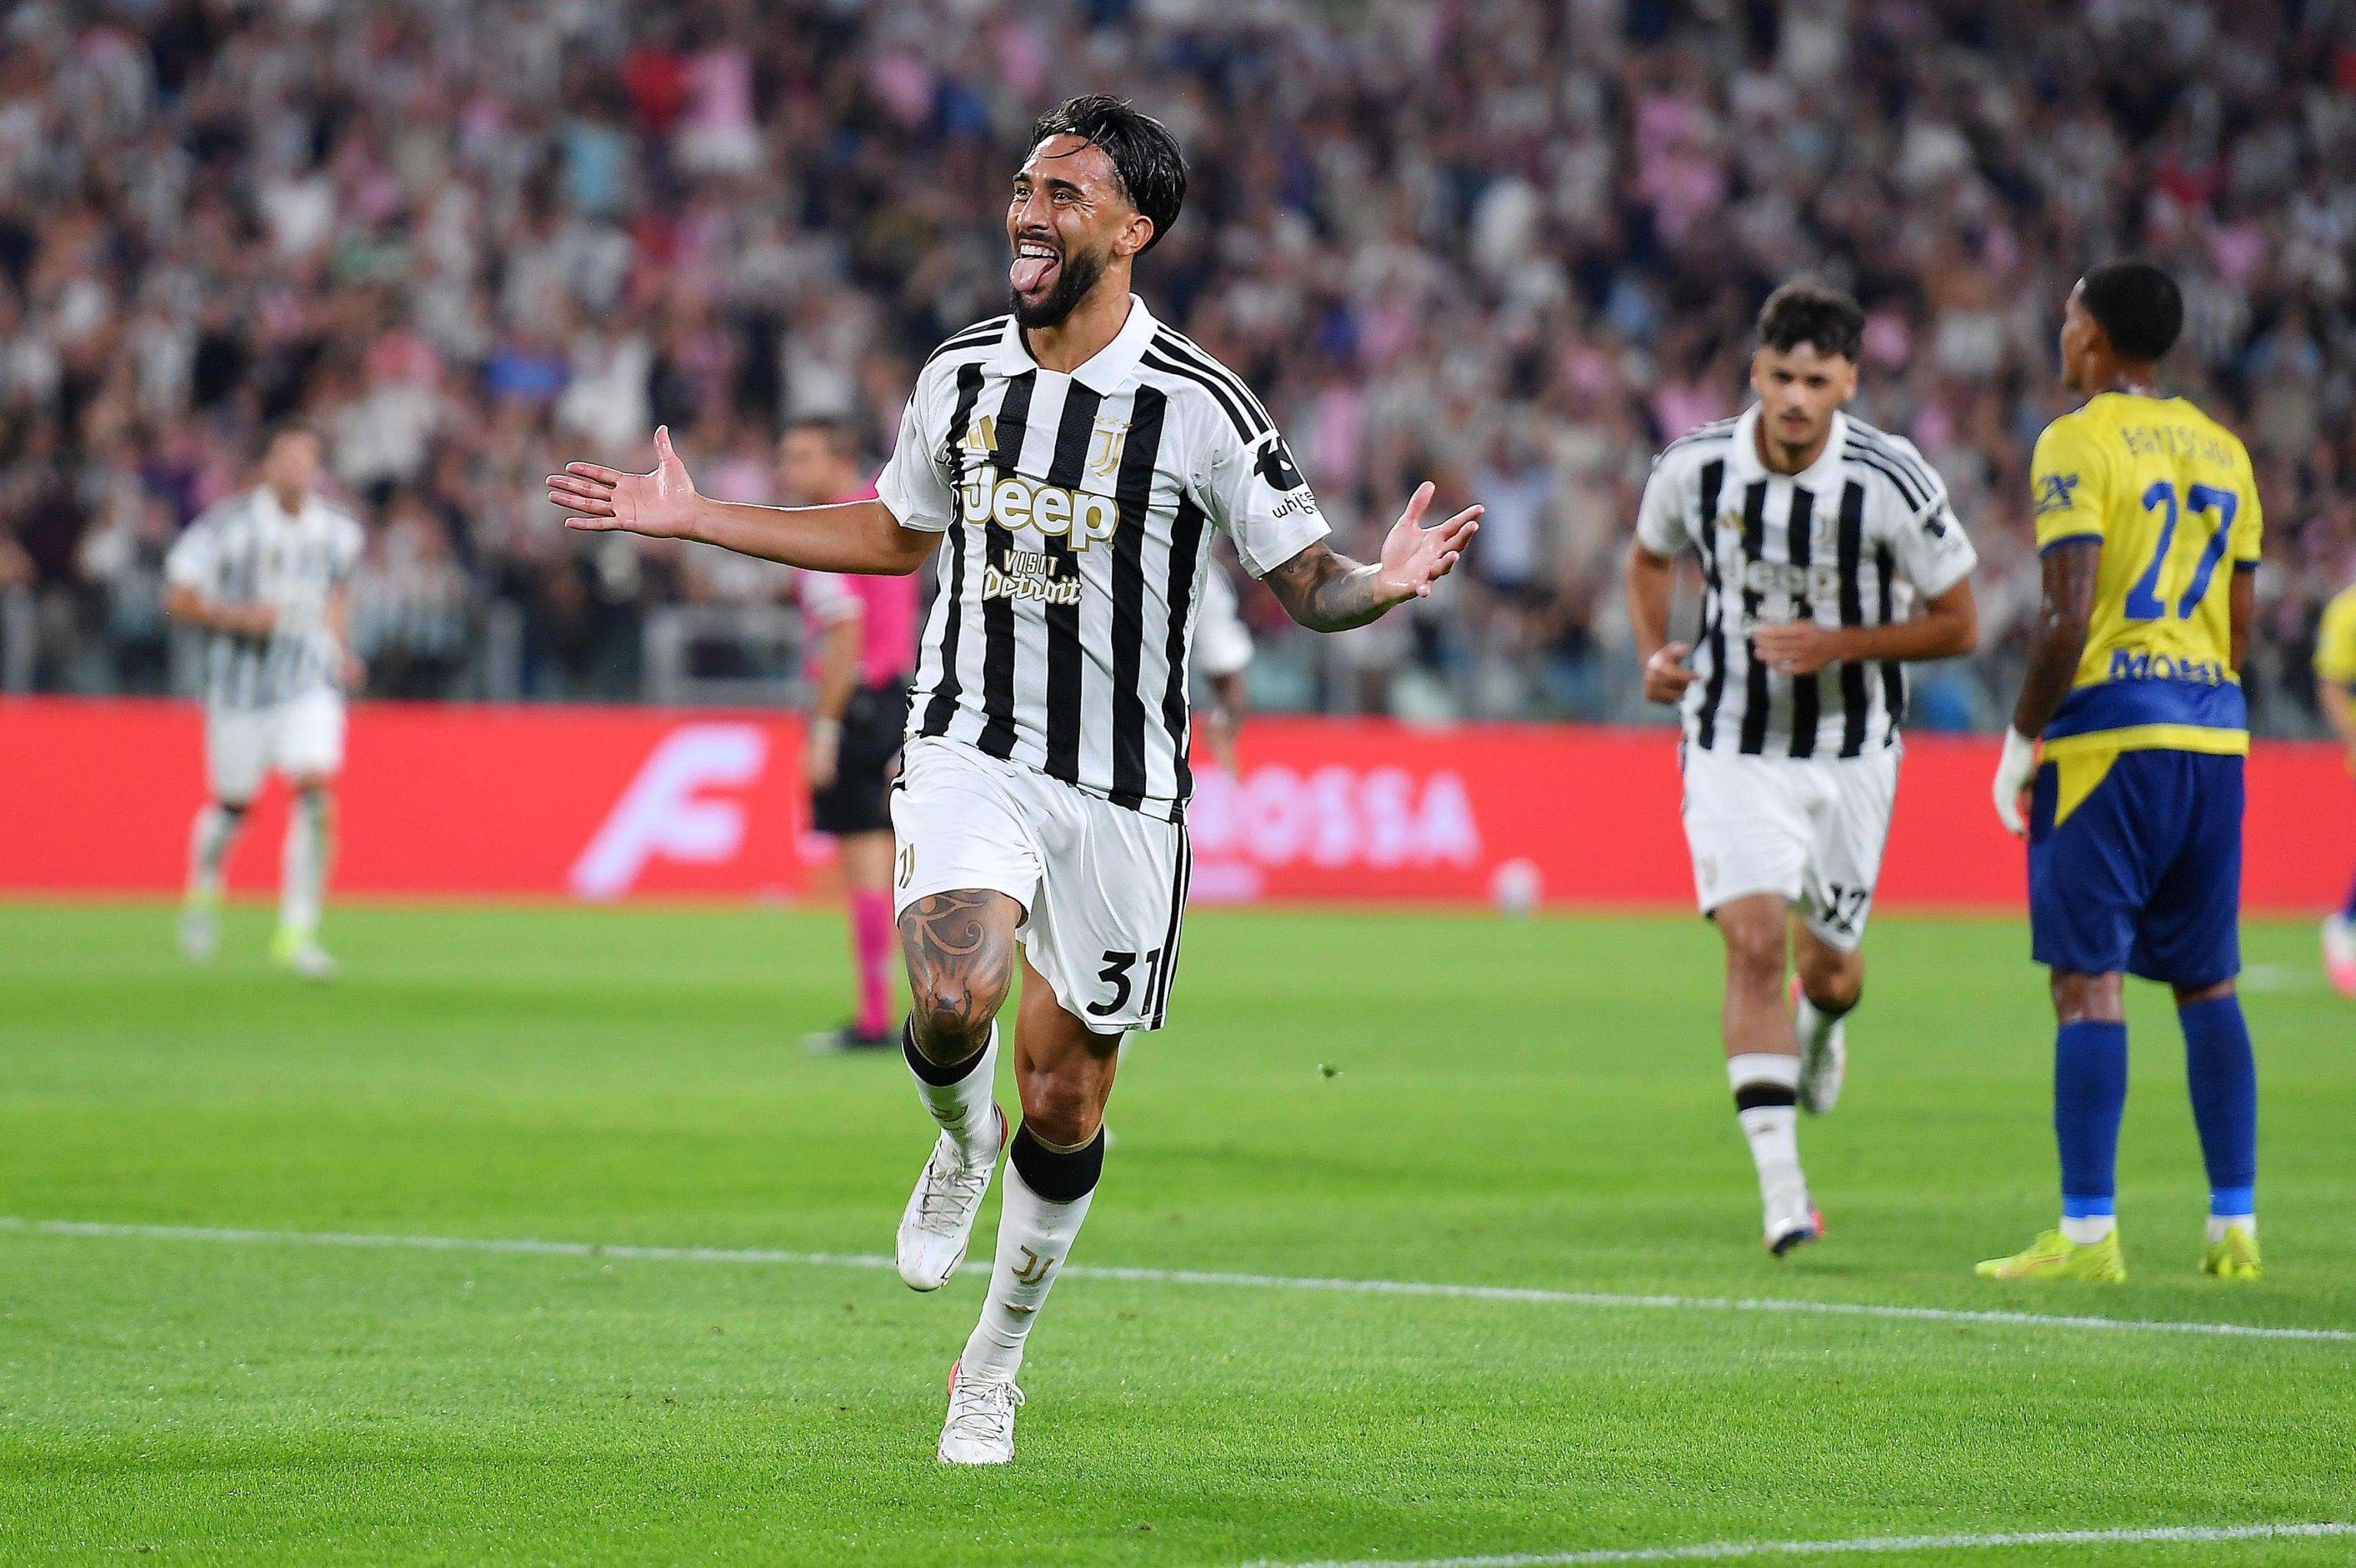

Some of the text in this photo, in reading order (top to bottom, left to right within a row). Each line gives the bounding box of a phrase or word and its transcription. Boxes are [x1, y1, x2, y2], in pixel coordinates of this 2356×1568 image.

[962, 464, 1120, 552] Jeep
[982, 564, 1083, 606] Detroit
[1004, 549, 1059, 577] VISIT
[2124, 479, 2238, 621] 27
[1086, 947, 1161, 1017] 31
